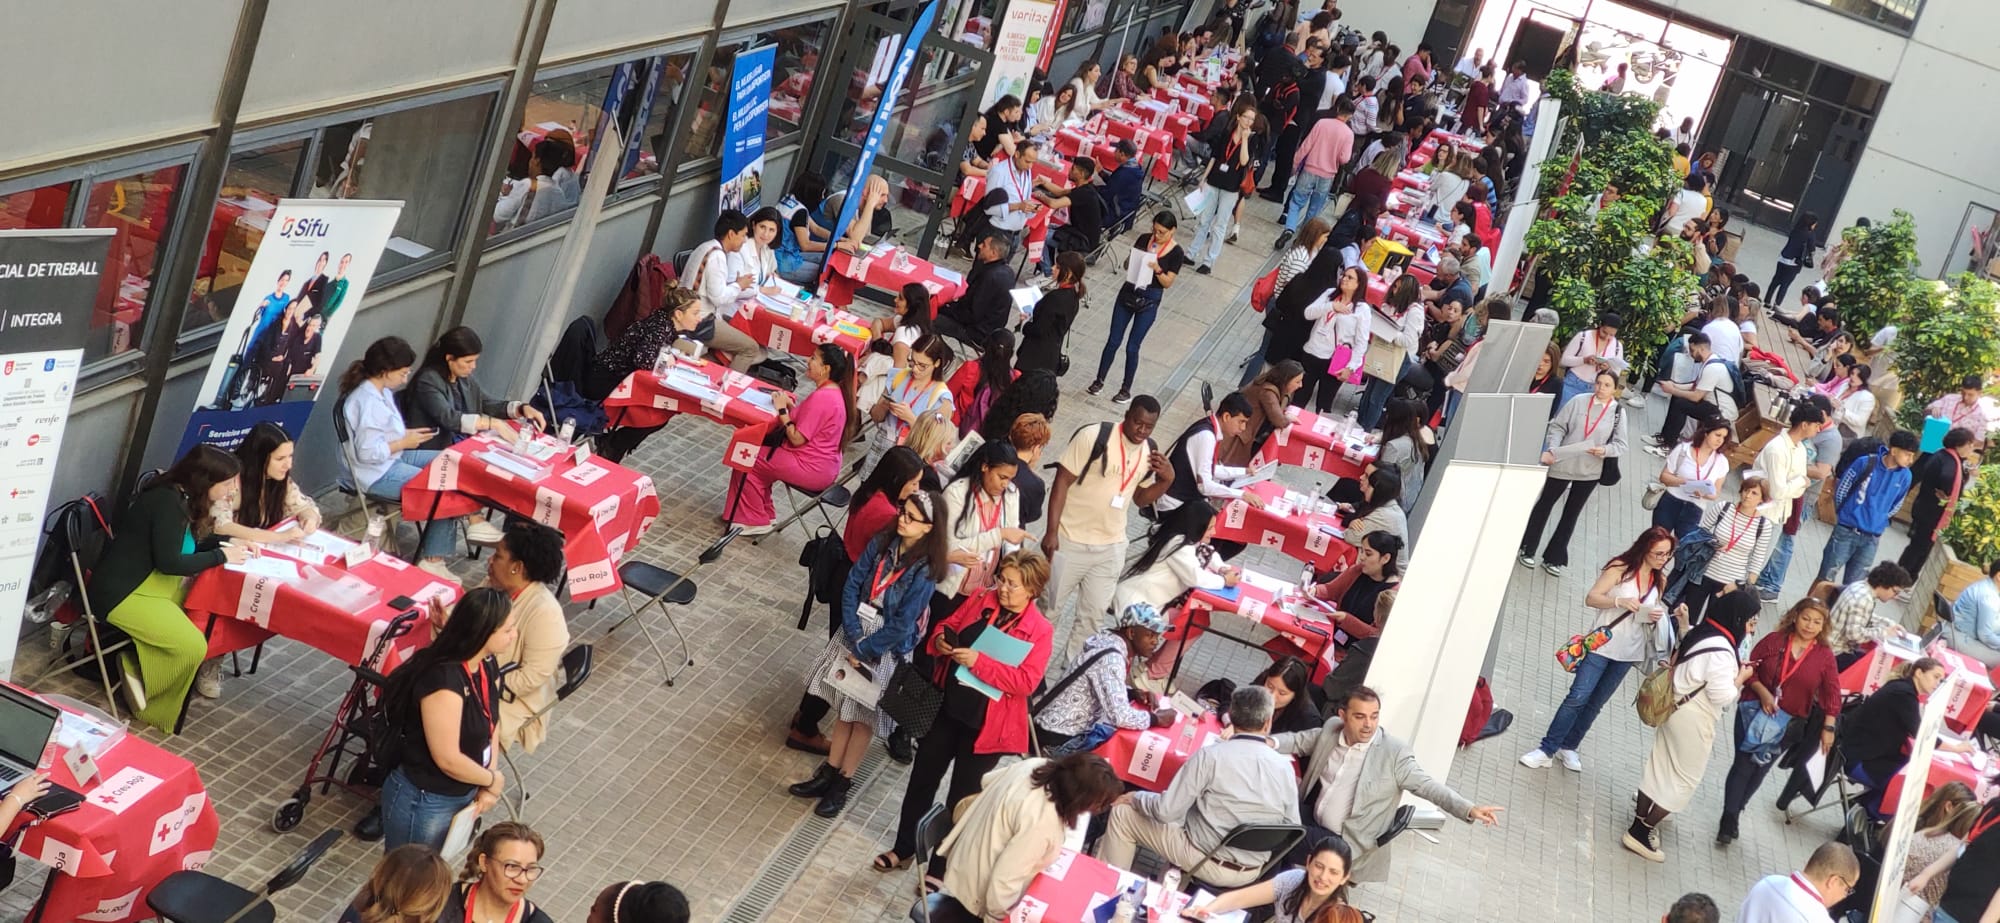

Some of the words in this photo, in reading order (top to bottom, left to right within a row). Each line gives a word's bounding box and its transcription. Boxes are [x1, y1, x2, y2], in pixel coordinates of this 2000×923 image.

[295, 217, 330, 237] Sifu
[27, 263, 46, 277] DE
[47, 261, 98, 276] TREBALL
[11, 311, 62, 328] INTEGRA
[35, 414, 60, 426] renfe
[589, 570, 608, 581] Roja
[250, 588, 263, 613] Creu
[1141, 753, 1153, 771] Roja
[55, 851, 66, 871] oja
[1020, 907, 1030, 923] Cre
